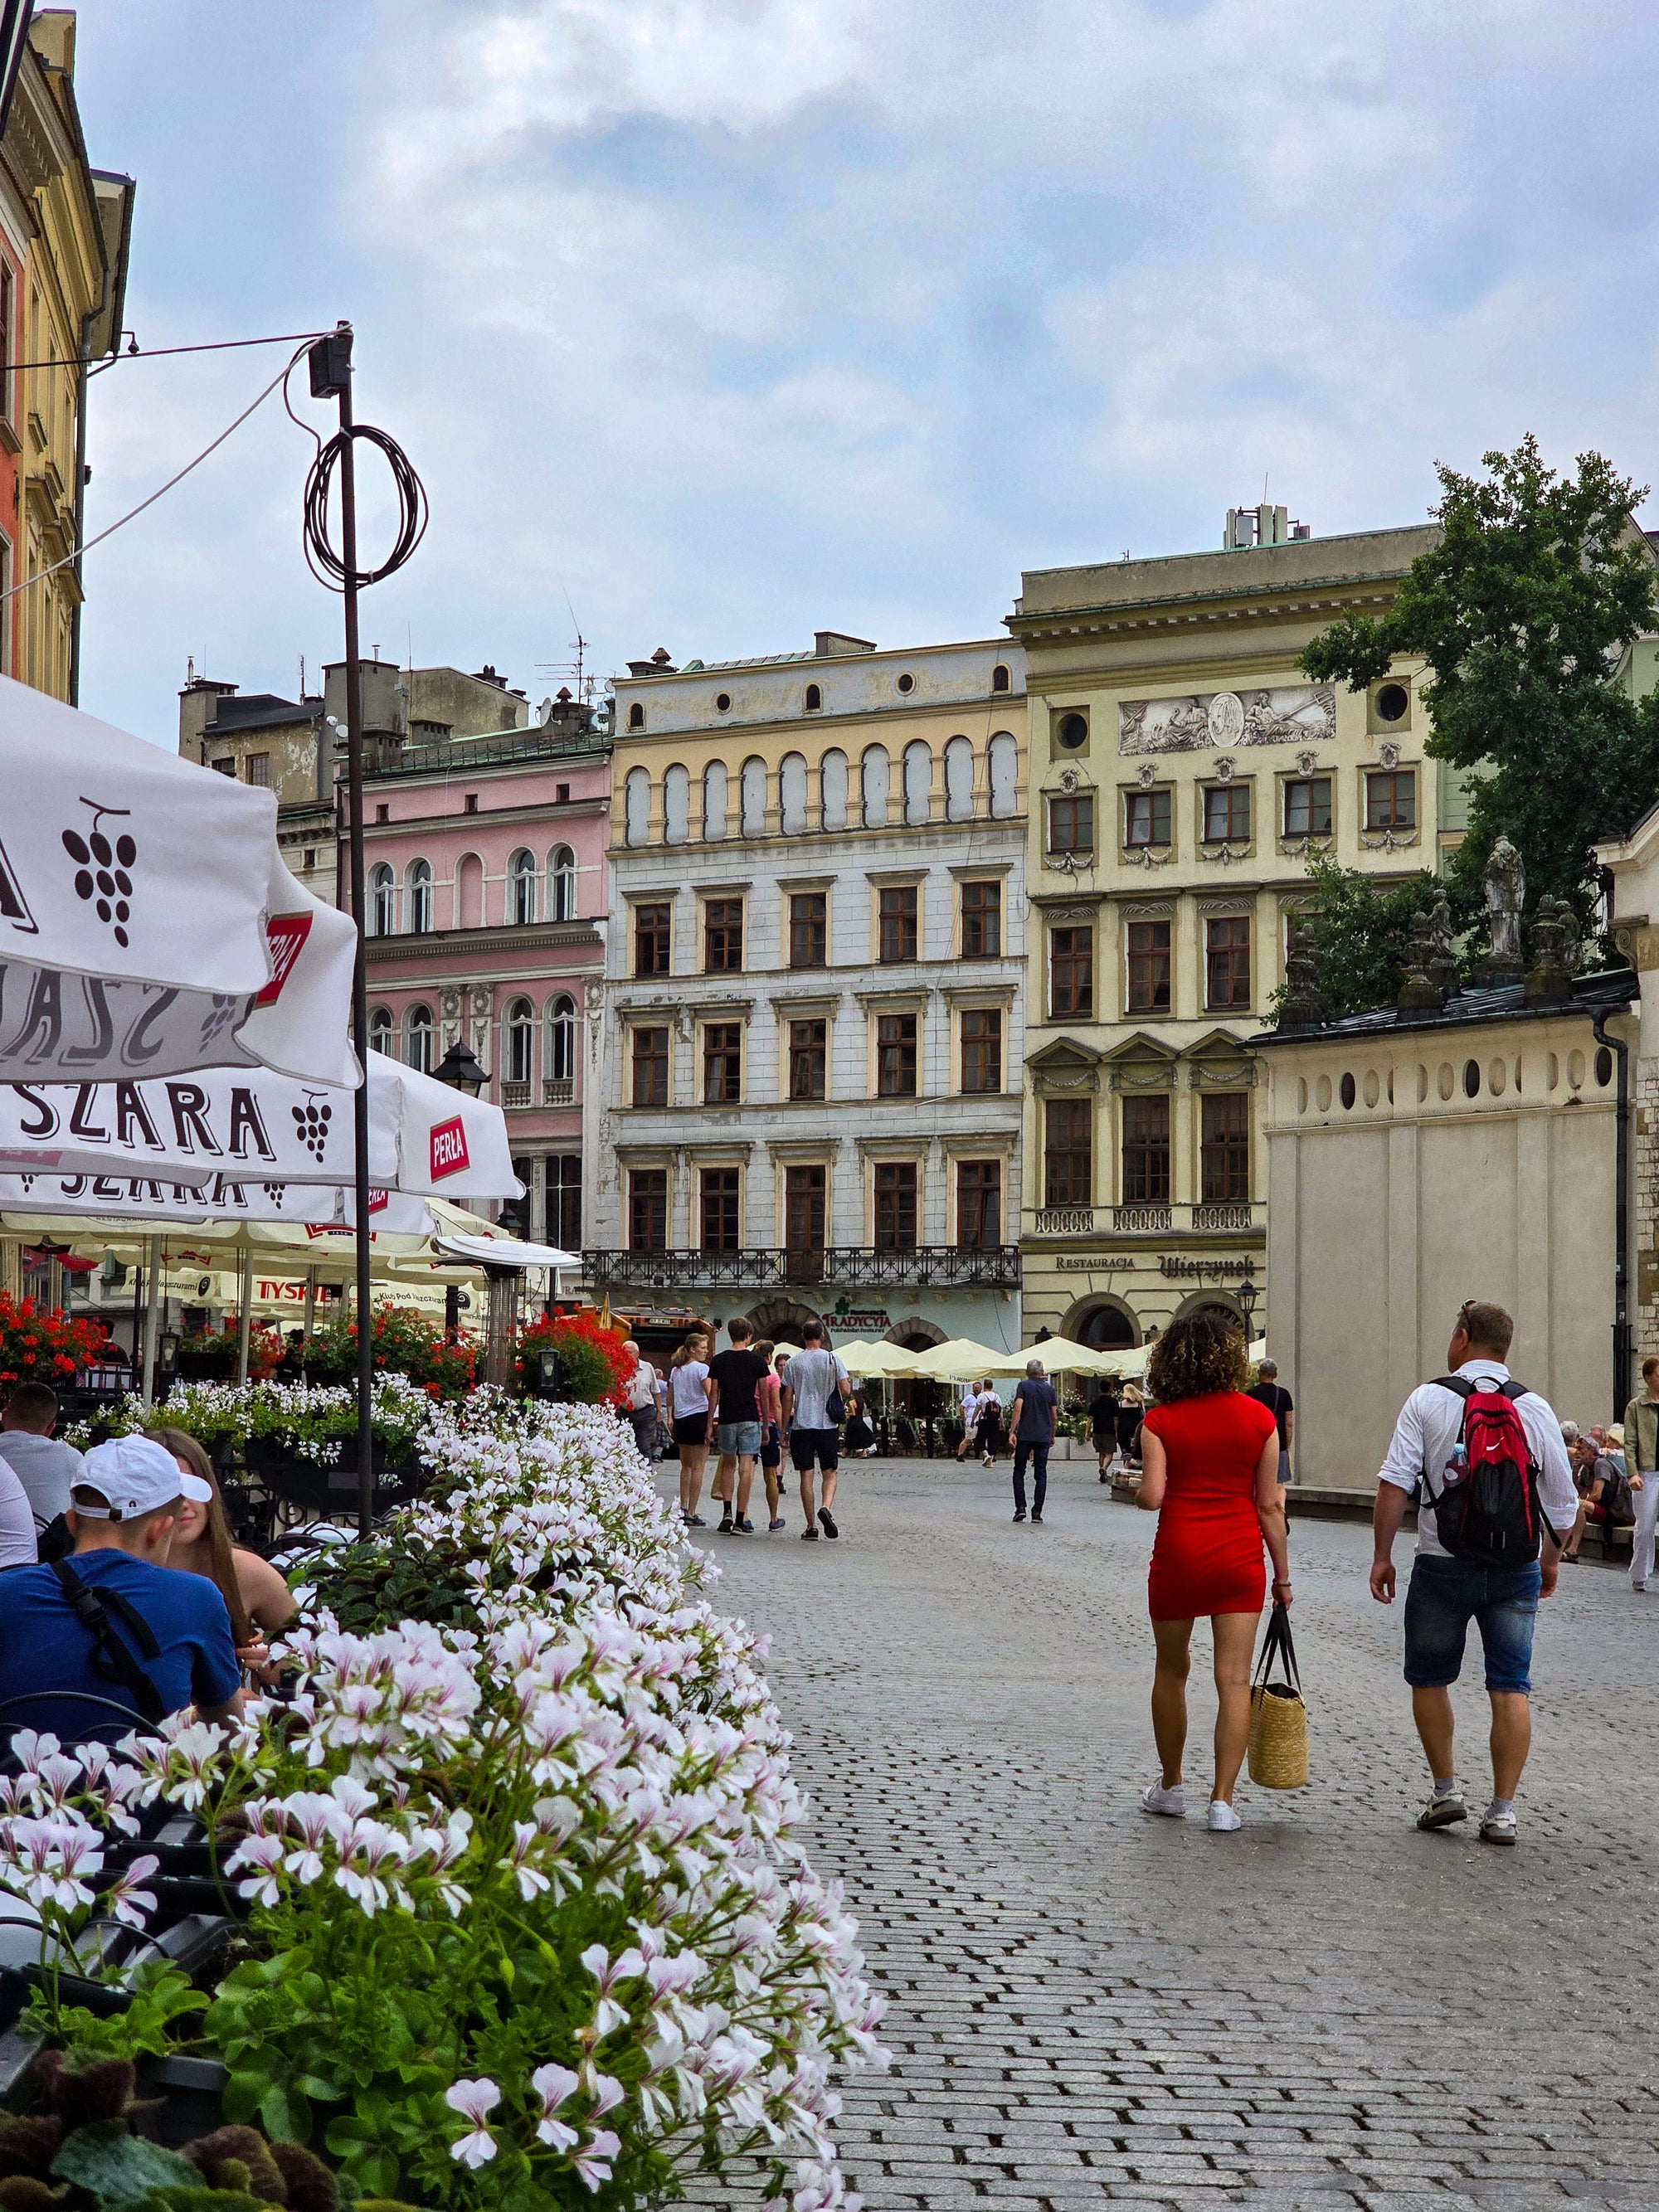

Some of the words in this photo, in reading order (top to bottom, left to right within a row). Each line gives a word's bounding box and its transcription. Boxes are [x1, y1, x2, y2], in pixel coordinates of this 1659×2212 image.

[12, 1082, 277, 1161] SZARA
[434, 1128, 465, 1168] PERŁA
[1056, 1257, 1135, 1270] RESTAURACJA
[1157, 1255, 1255, 1281] Wierzynek
[822, 1313, 892, 1329] TRADYCYJA
